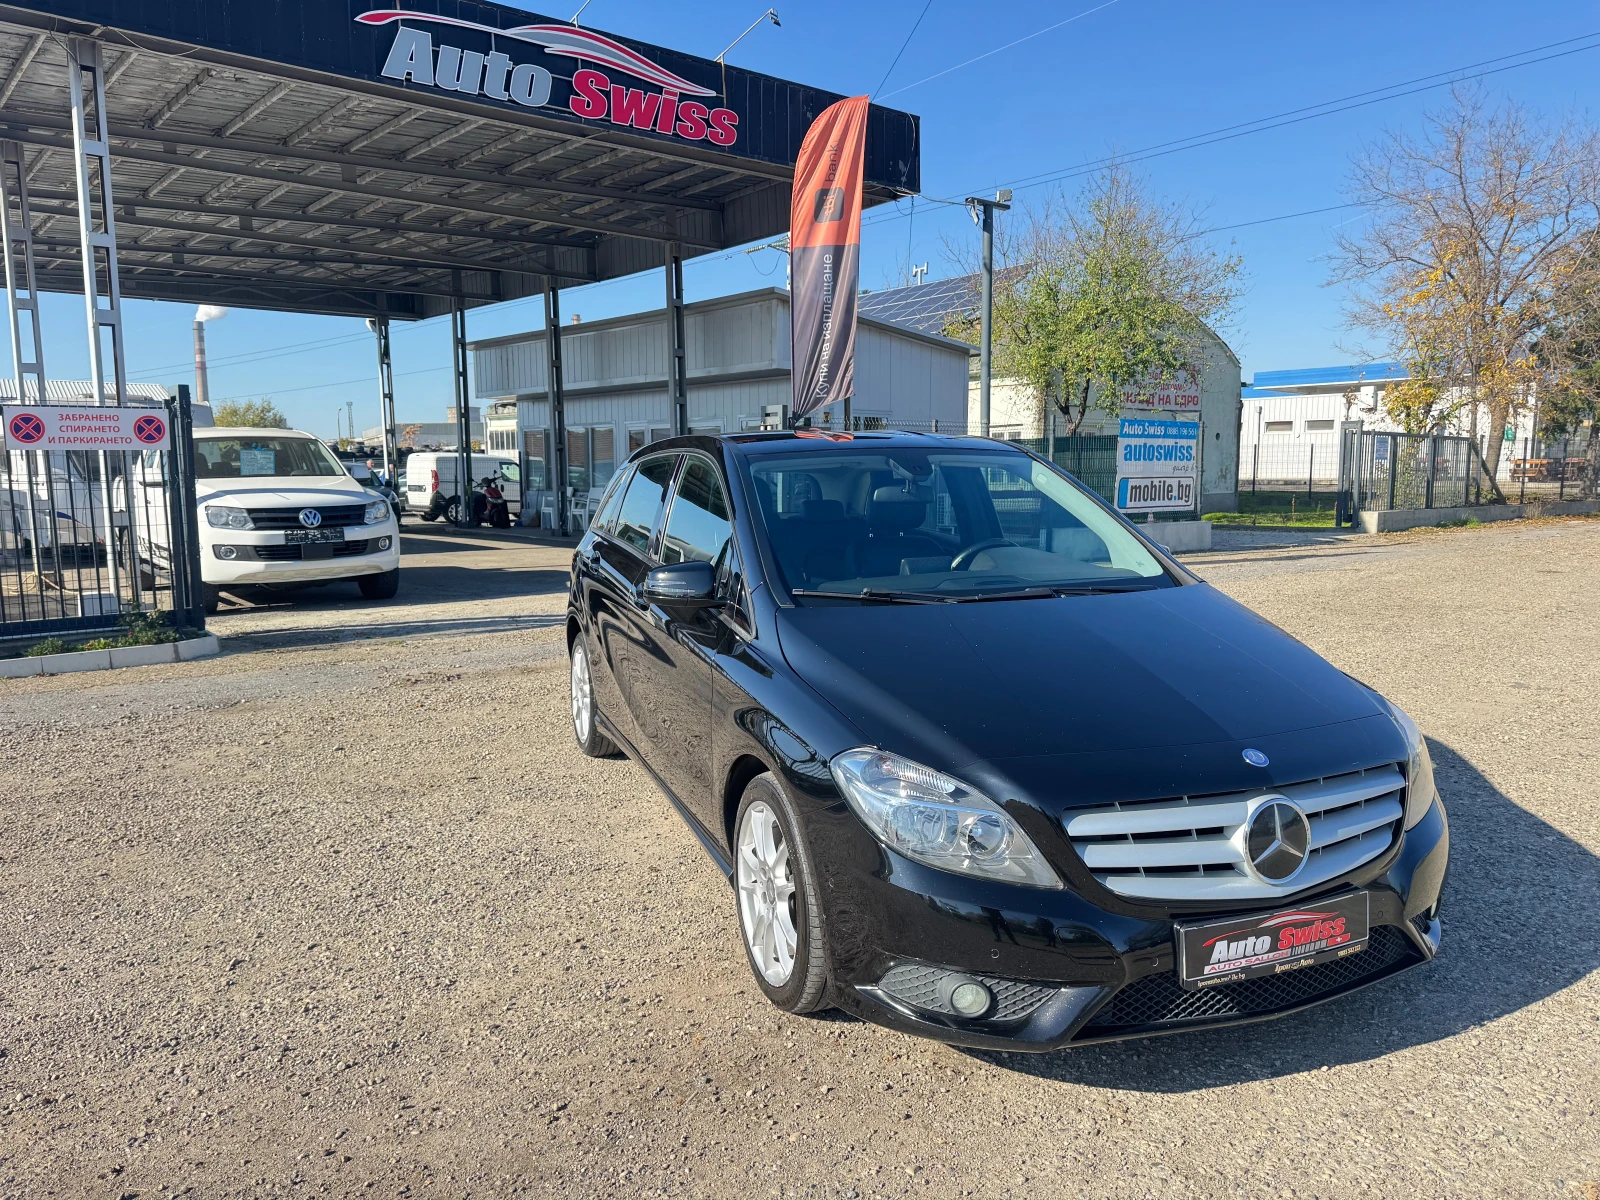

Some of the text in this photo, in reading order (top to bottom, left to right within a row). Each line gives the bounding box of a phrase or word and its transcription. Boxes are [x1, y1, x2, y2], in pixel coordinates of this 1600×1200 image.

[381, 27, 739, 146] Auto Swiss
[825, 142, 839, 182] bank
[816, 253, 833, 398] Купи на изплащане
[1158, 394, 1171, 406] НА
[58, 413, 120, 422] ЗАБРАНЕНО
[59, 425, 120, 433] СПИРАНЕТО
[1122, 422, 1143, 435] Auto
[1144, 422, 1165, 436] Swiss
[48, 436, 132, 445] И ПАРКИРАНЕТО
[1129, 479, 1192, 503] mobile.bg
[1210, 917, 1346, 964] Auto Swiss
[1208, 951, 1289, 973] AUTO SALLON
